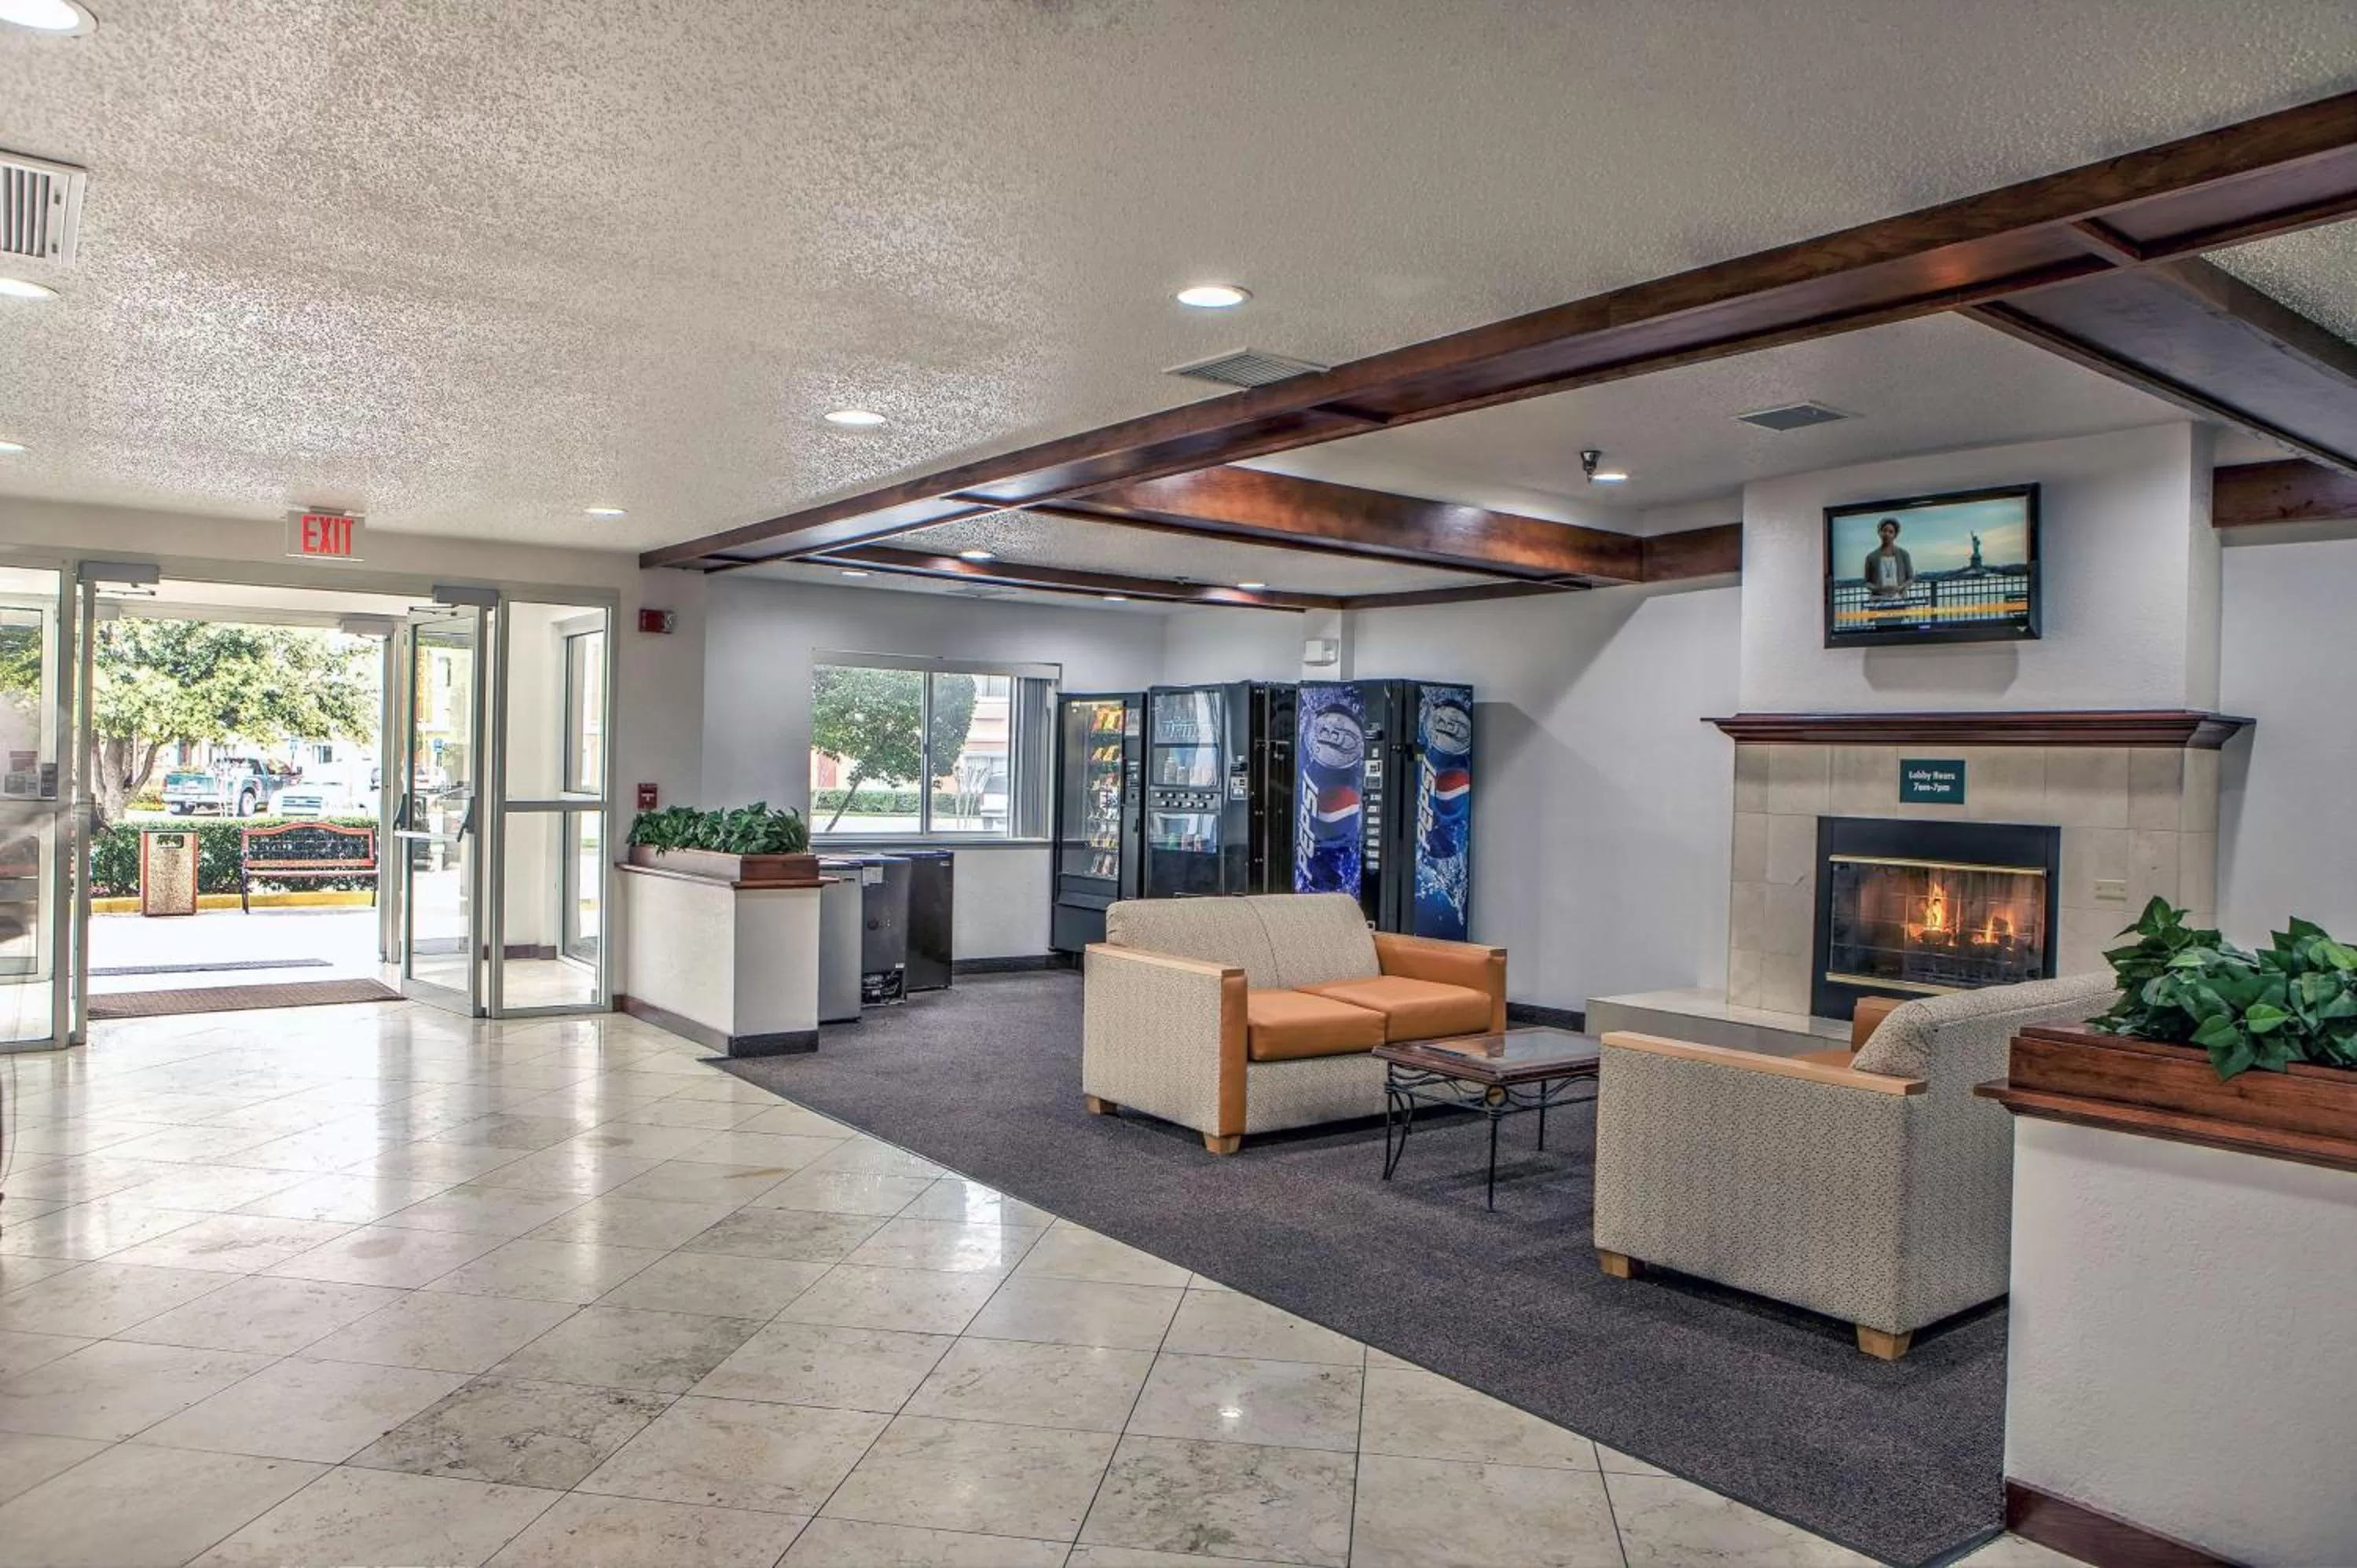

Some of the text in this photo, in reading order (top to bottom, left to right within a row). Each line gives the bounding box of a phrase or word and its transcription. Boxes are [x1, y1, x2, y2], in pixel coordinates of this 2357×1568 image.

[302, 515, 354, 555] EXIT
[1417, 754, 1437, 852] PEPSI
[1908, 771, 1956, 781] Lobby Hours
[1296, 769, 1319, 881] PEPSI
